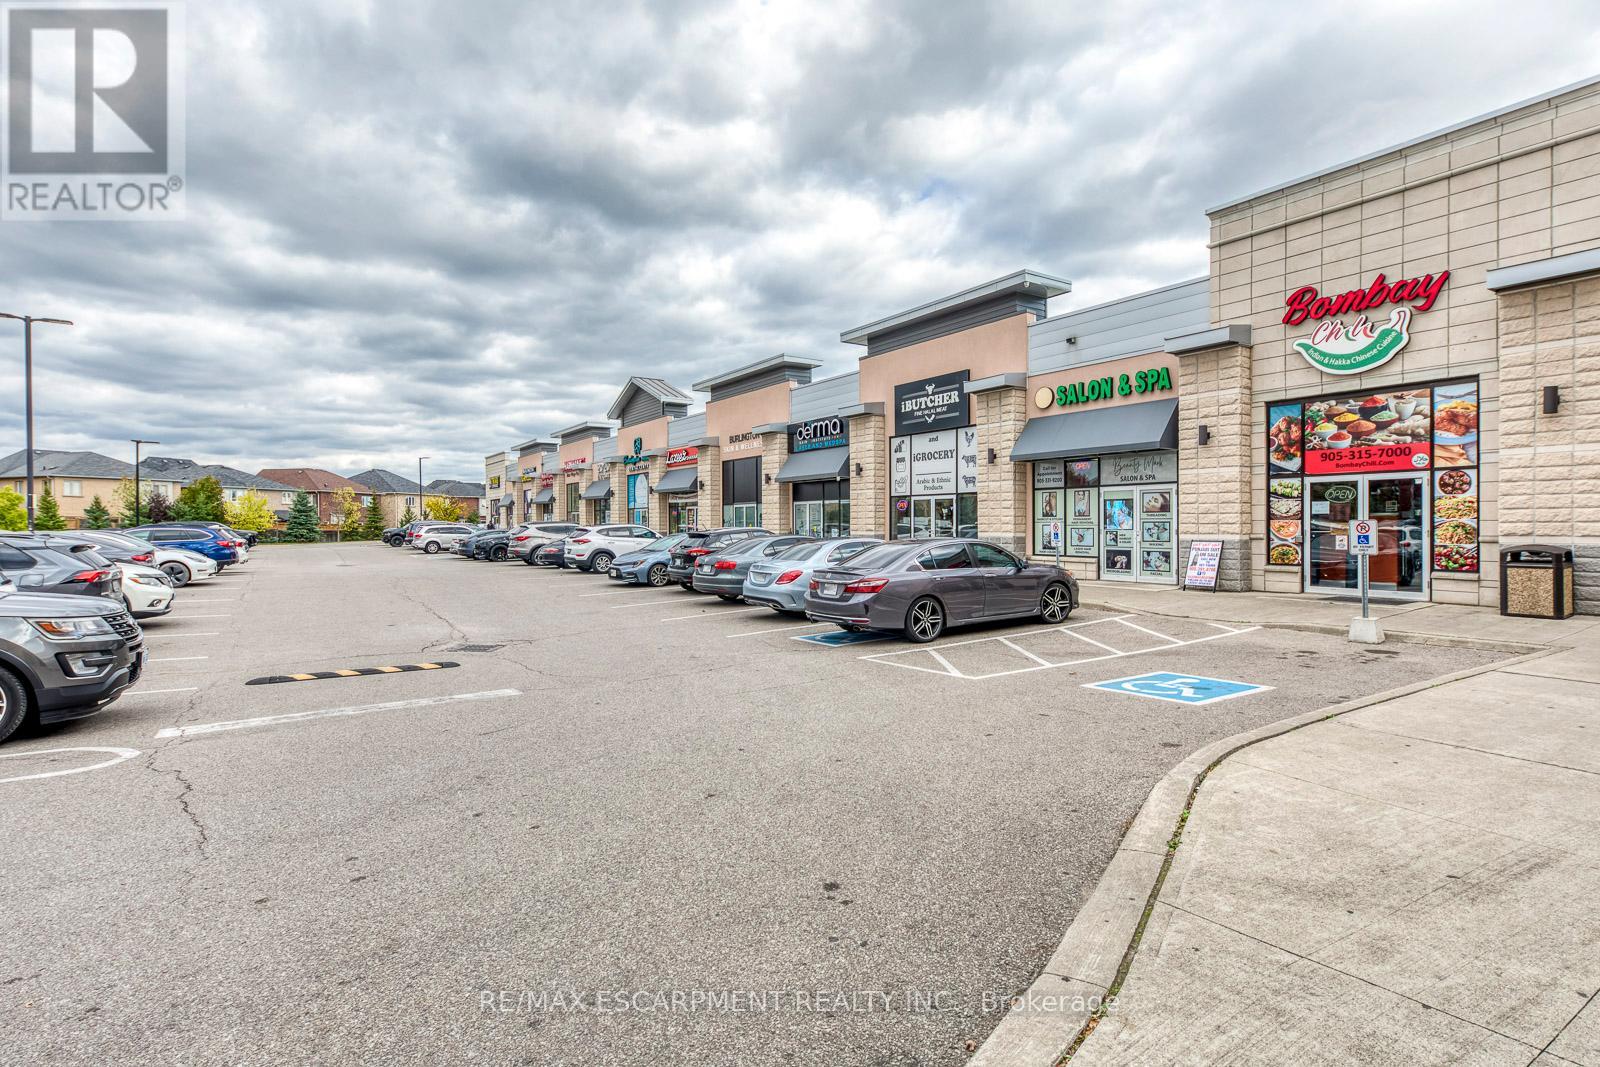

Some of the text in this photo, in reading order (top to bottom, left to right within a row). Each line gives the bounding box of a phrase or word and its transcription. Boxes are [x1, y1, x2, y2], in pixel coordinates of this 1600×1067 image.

[1282, 270, 1450, 326] Bombay
[1307, 347, 1324, 362] Indian
[1351, 349, 1379, 364] Chinese
[1376, 331, 1398, 350] Cuisine
[1056, 367, 1173, 407] SALON & SPA
[901, 390, 960, 412] iBUTCHER
[797, 418, 840, 440] derma
[913, 449, 955, 462] iGROCERY
[1320, 446, 1412, 462] 905-315-7000
[1327, 488, 1353, 499] OPEN
